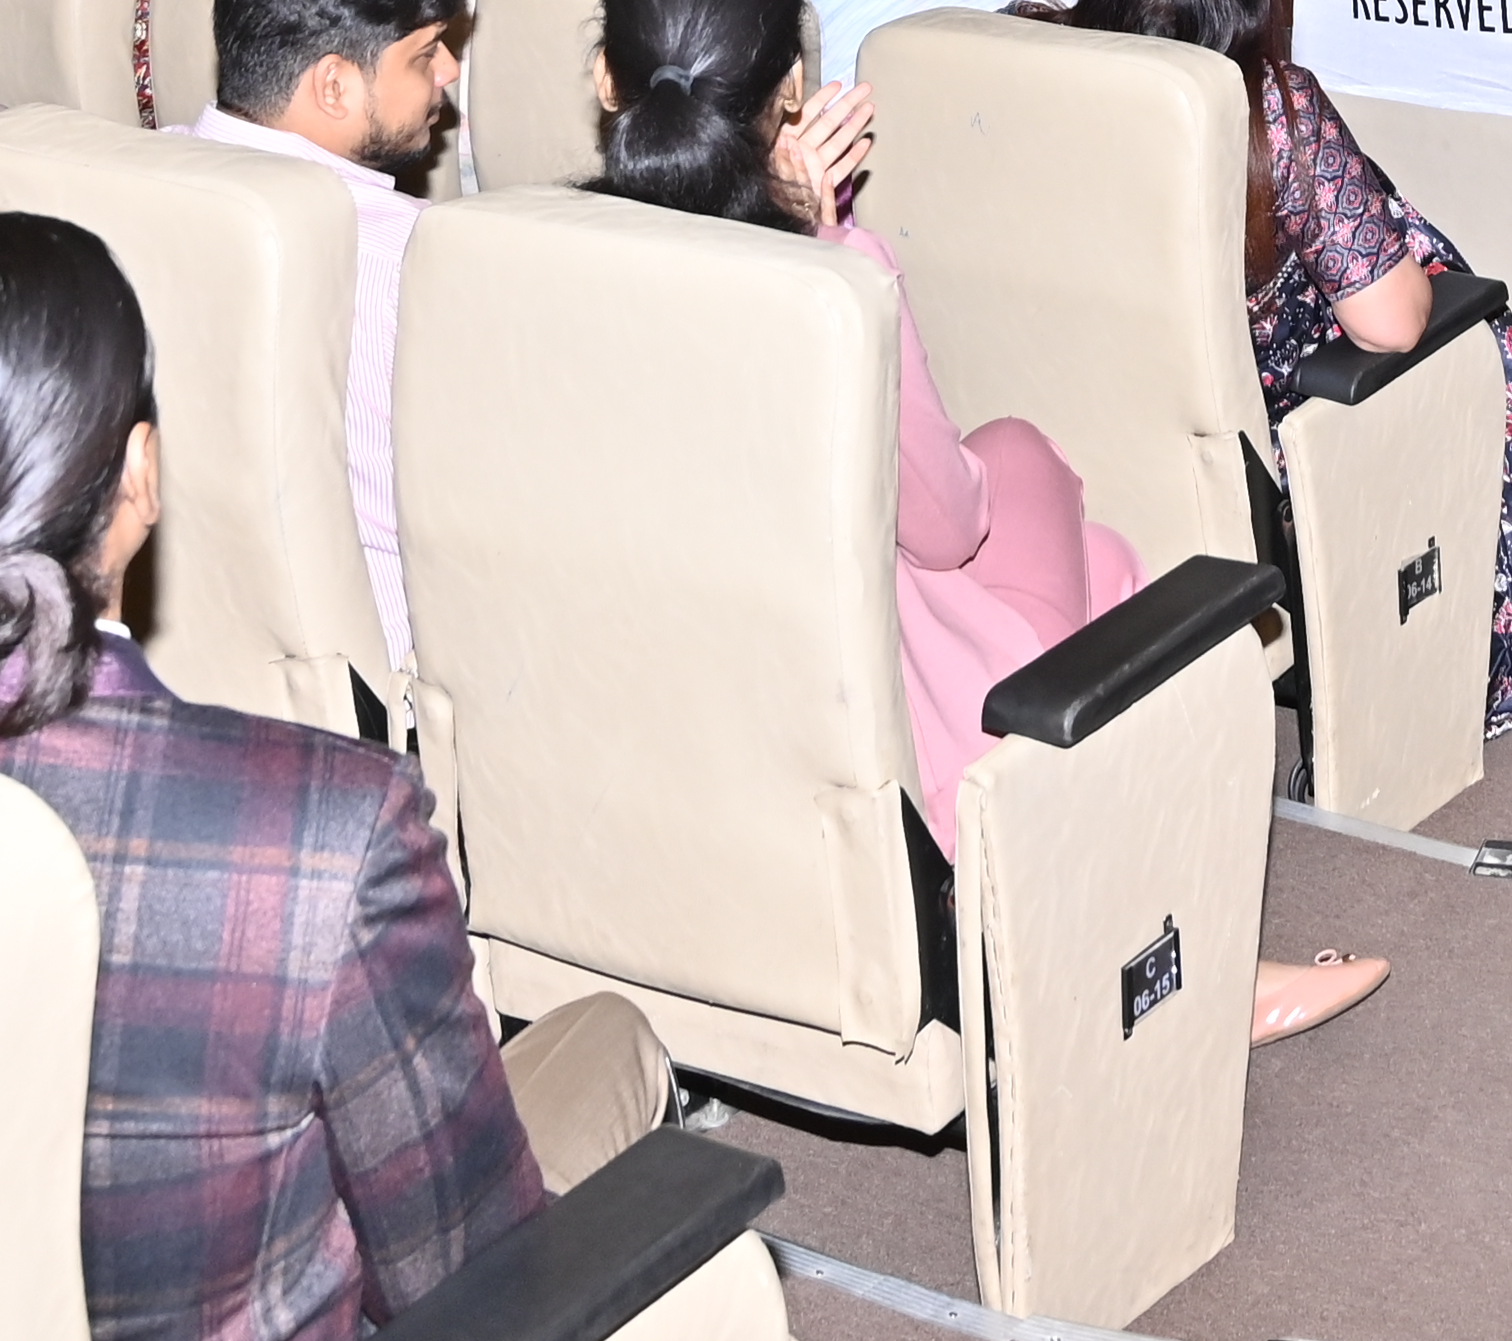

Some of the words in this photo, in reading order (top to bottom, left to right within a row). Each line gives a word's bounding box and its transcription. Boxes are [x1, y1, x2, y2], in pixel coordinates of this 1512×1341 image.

[1415, 558, 1422, 574] B
[1145, 956, 1156, 978] C
[1134, 972, 1171, 1017] 06-15
